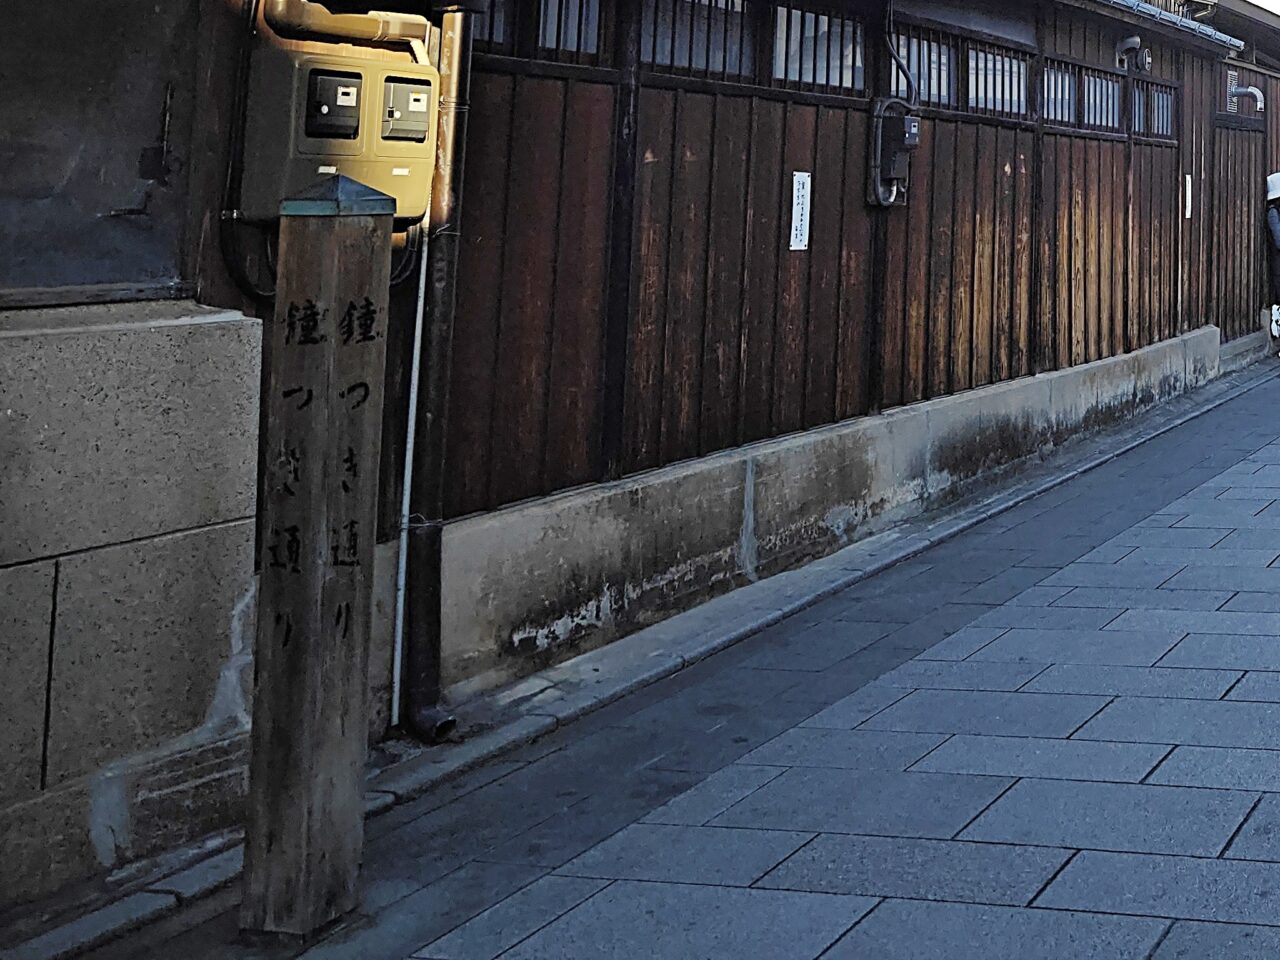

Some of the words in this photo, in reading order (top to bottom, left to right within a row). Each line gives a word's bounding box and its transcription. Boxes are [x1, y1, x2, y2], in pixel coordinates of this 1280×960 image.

[331, 297, 382, 640] 鐘つき通り
